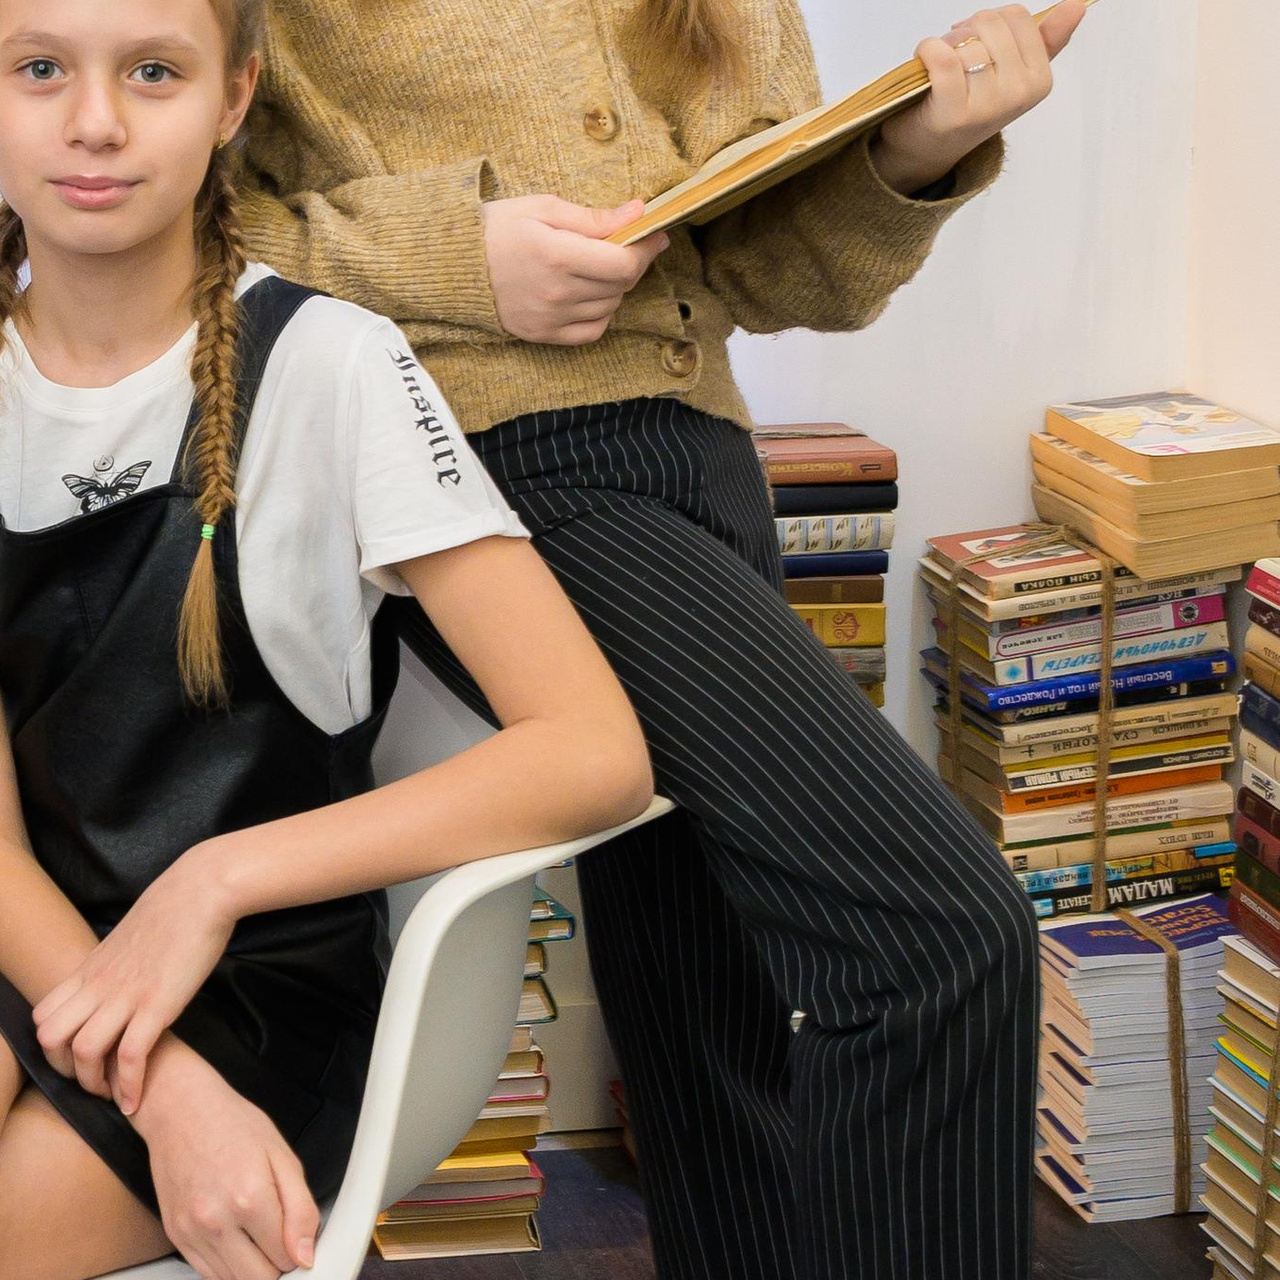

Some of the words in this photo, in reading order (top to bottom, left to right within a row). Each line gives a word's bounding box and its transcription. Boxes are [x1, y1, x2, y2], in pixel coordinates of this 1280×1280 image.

[385, 346, 463, 490] Inspire
[1020, 577, 1064, 591] ПОЛКА
[1069, 572, 1098, 584] СЫН
[1112, 632, 1208, 661] ДЕВЧОНОЧЬИ
[1087, 677, 1124, 694] Ноый
[1126, 670, 1173, 687] Веселый
[997, 689, 1056, 706] Рождество
[1052, 736, 1099, 753] КОРЫЙ
[1107, 877, 1175, 905] МАДАМ
[1143, 905, 1212, 926] Scratc
